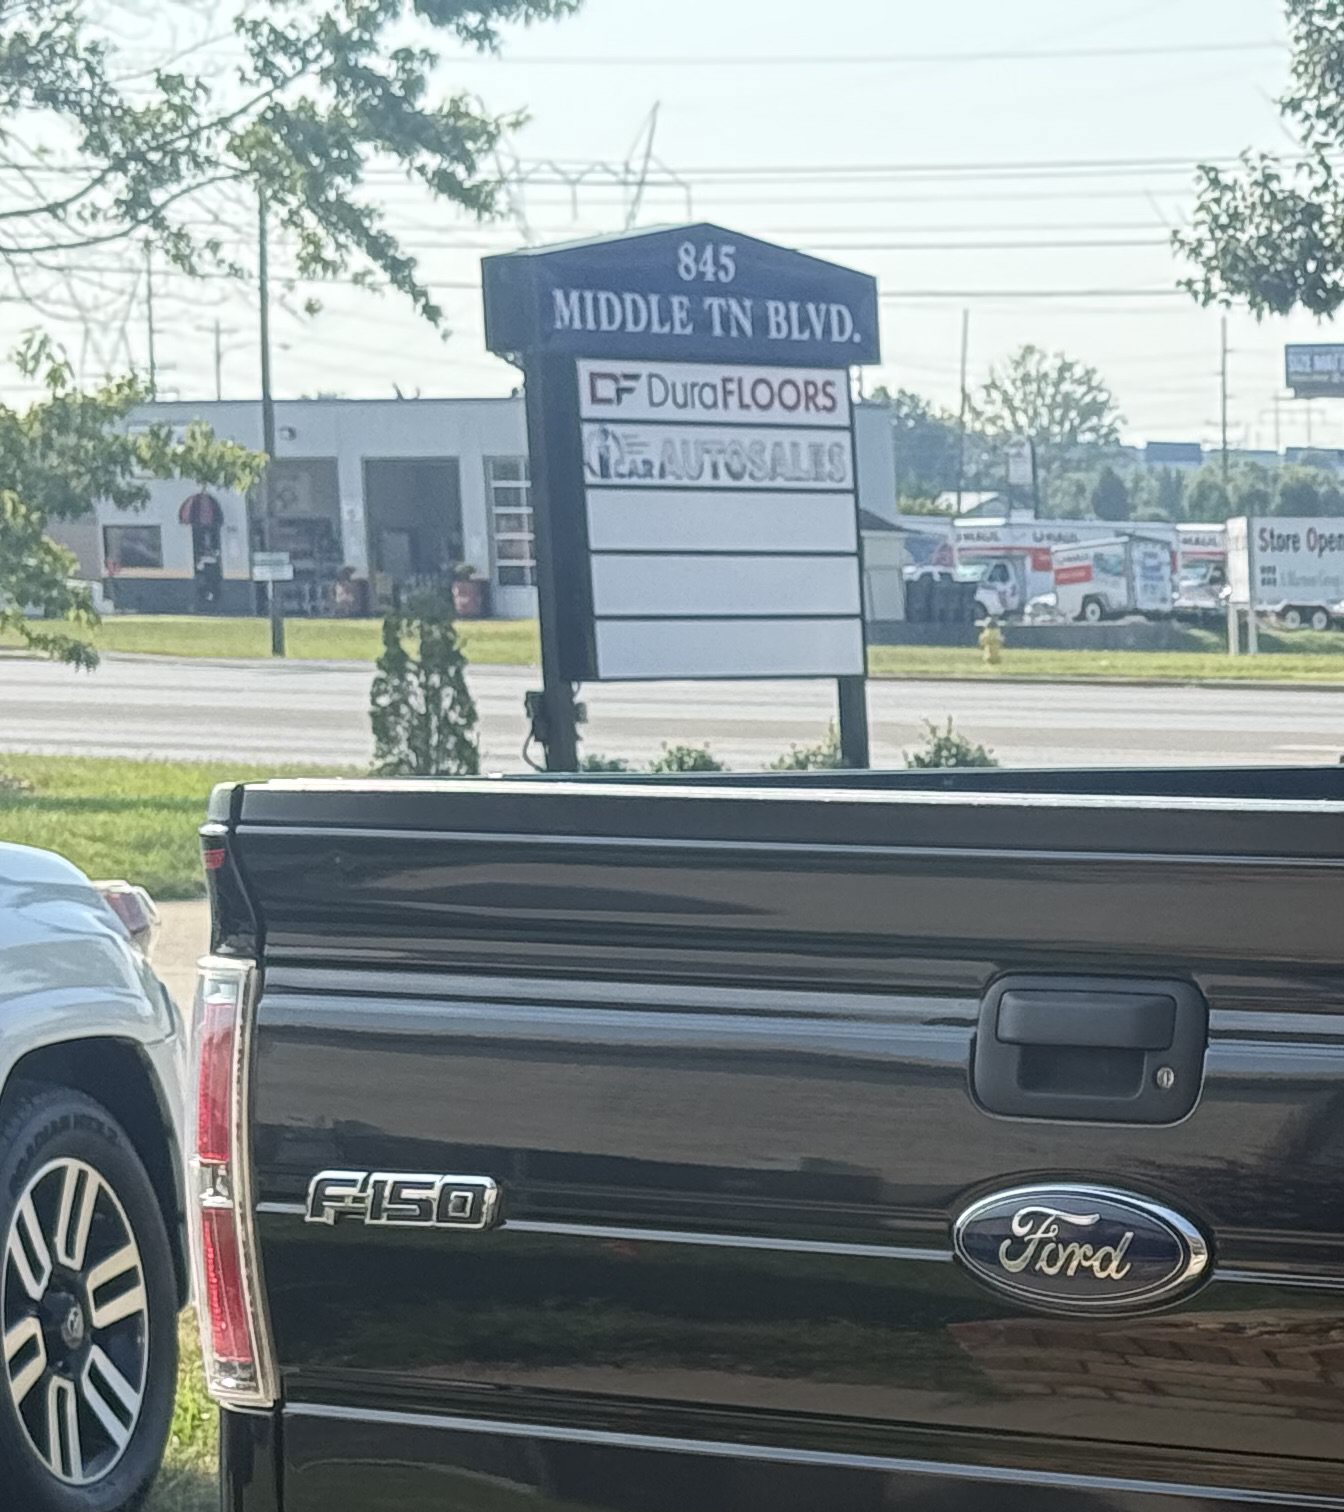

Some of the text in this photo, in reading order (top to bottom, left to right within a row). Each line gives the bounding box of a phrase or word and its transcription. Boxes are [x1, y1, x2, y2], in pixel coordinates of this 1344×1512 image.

[678, 241, 737, 283] 845
[552, 287, 862, 343] MIDDLE TN BLVD.
[647, 373, 838, 414] DuraFLOORS
[1258, 527, 1300, 552] Store
[998, 1206, 1135, 1280] Ford
